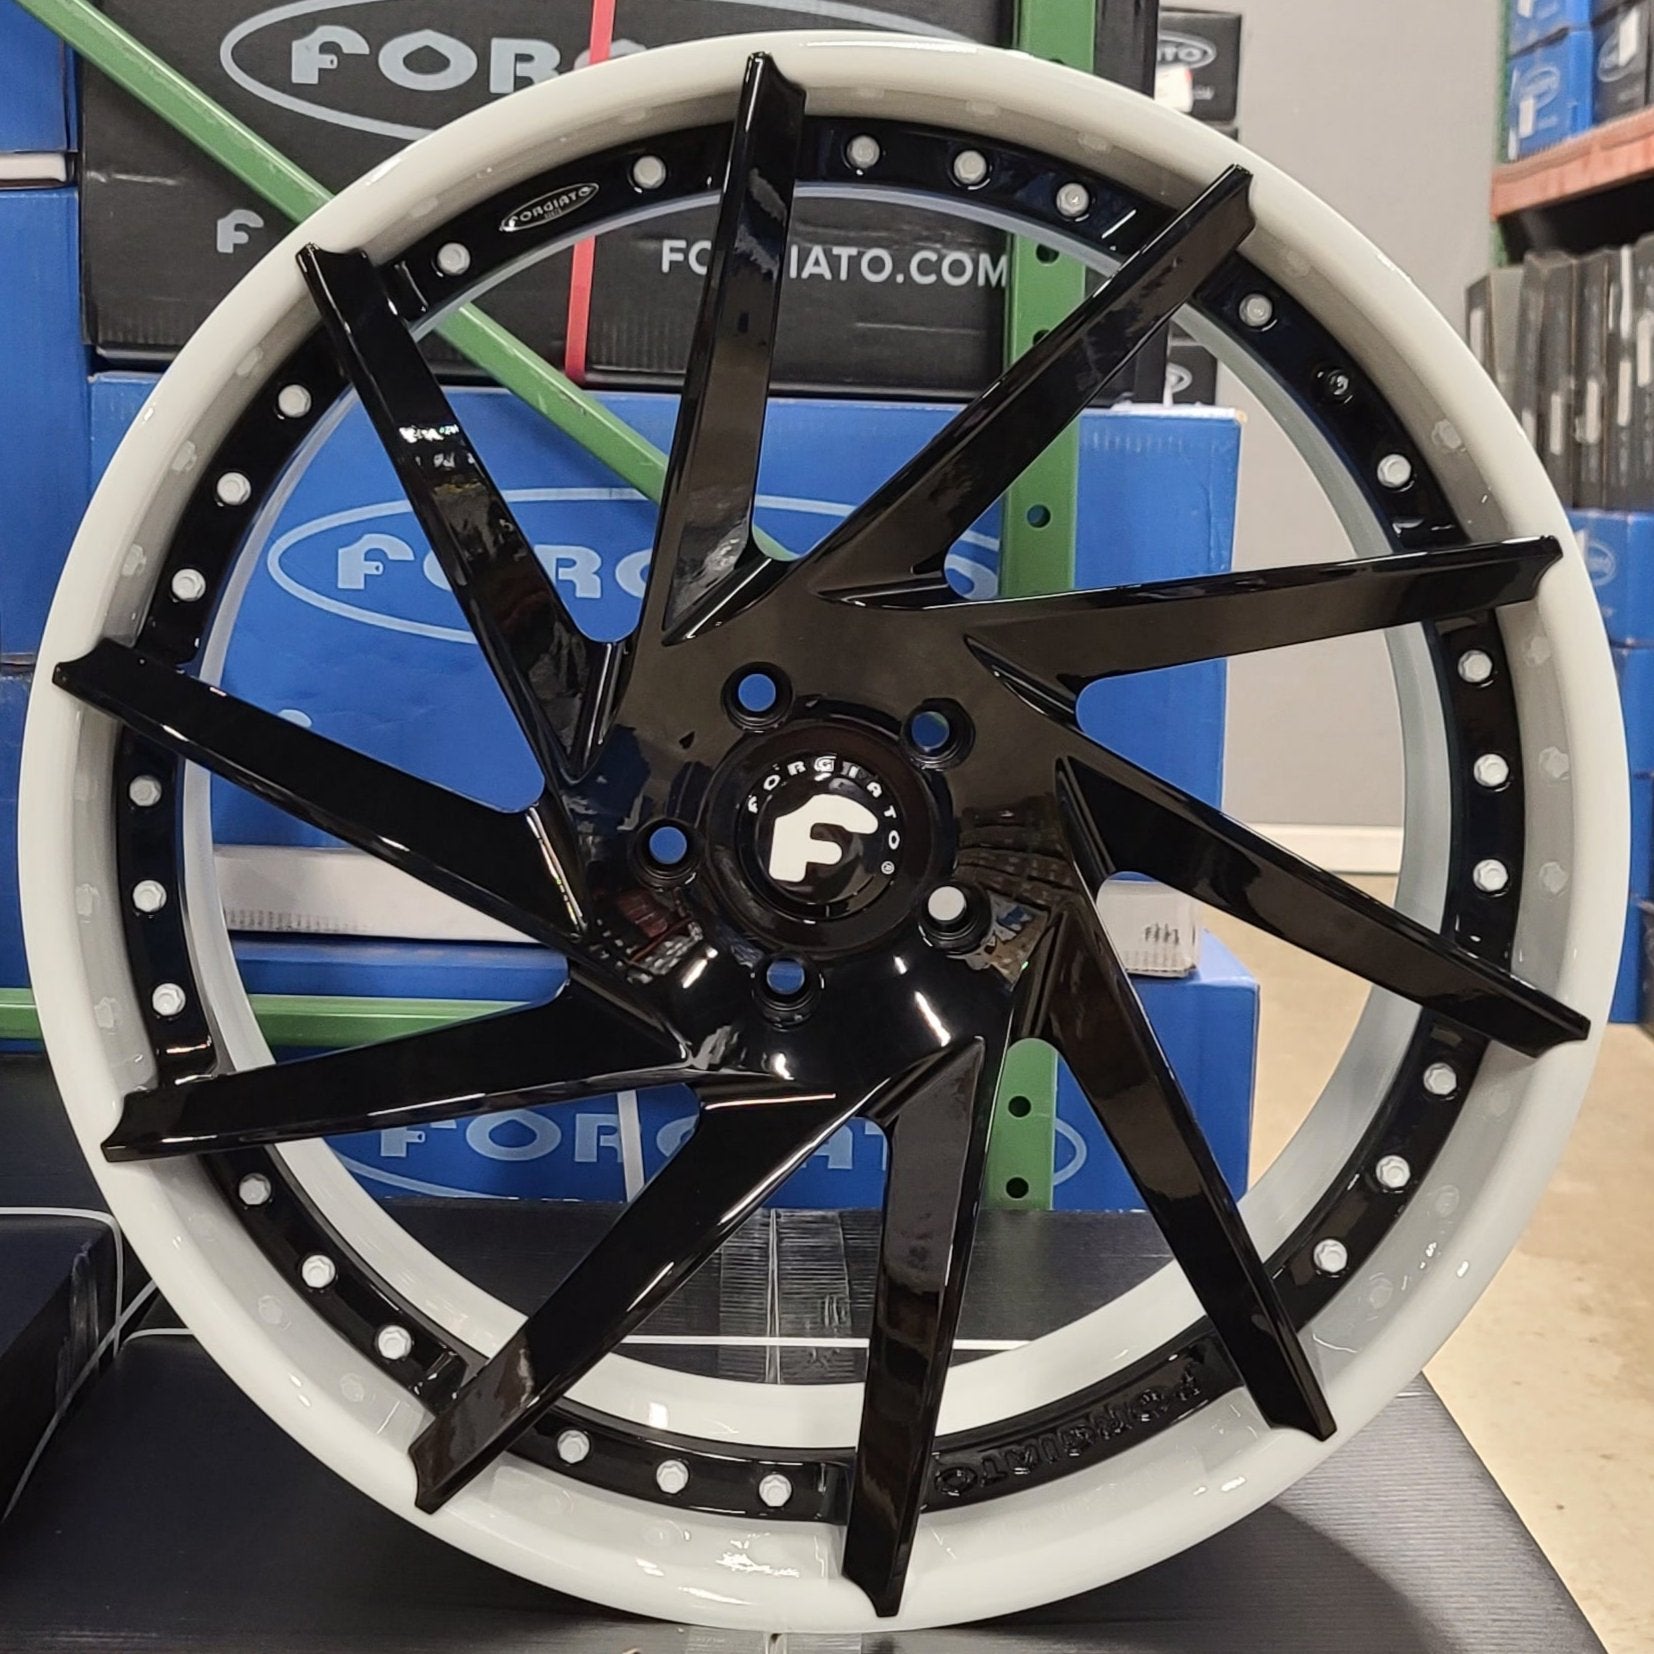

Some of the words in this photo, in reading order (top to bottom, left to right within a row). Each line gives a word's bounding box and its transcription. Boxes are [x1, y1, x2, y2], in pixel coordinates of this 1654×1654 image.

[291, 26, 647, 94] FOR
[661, 239, 1007, 287] FOIATO.COM
[769, 794, 879, 881] F
